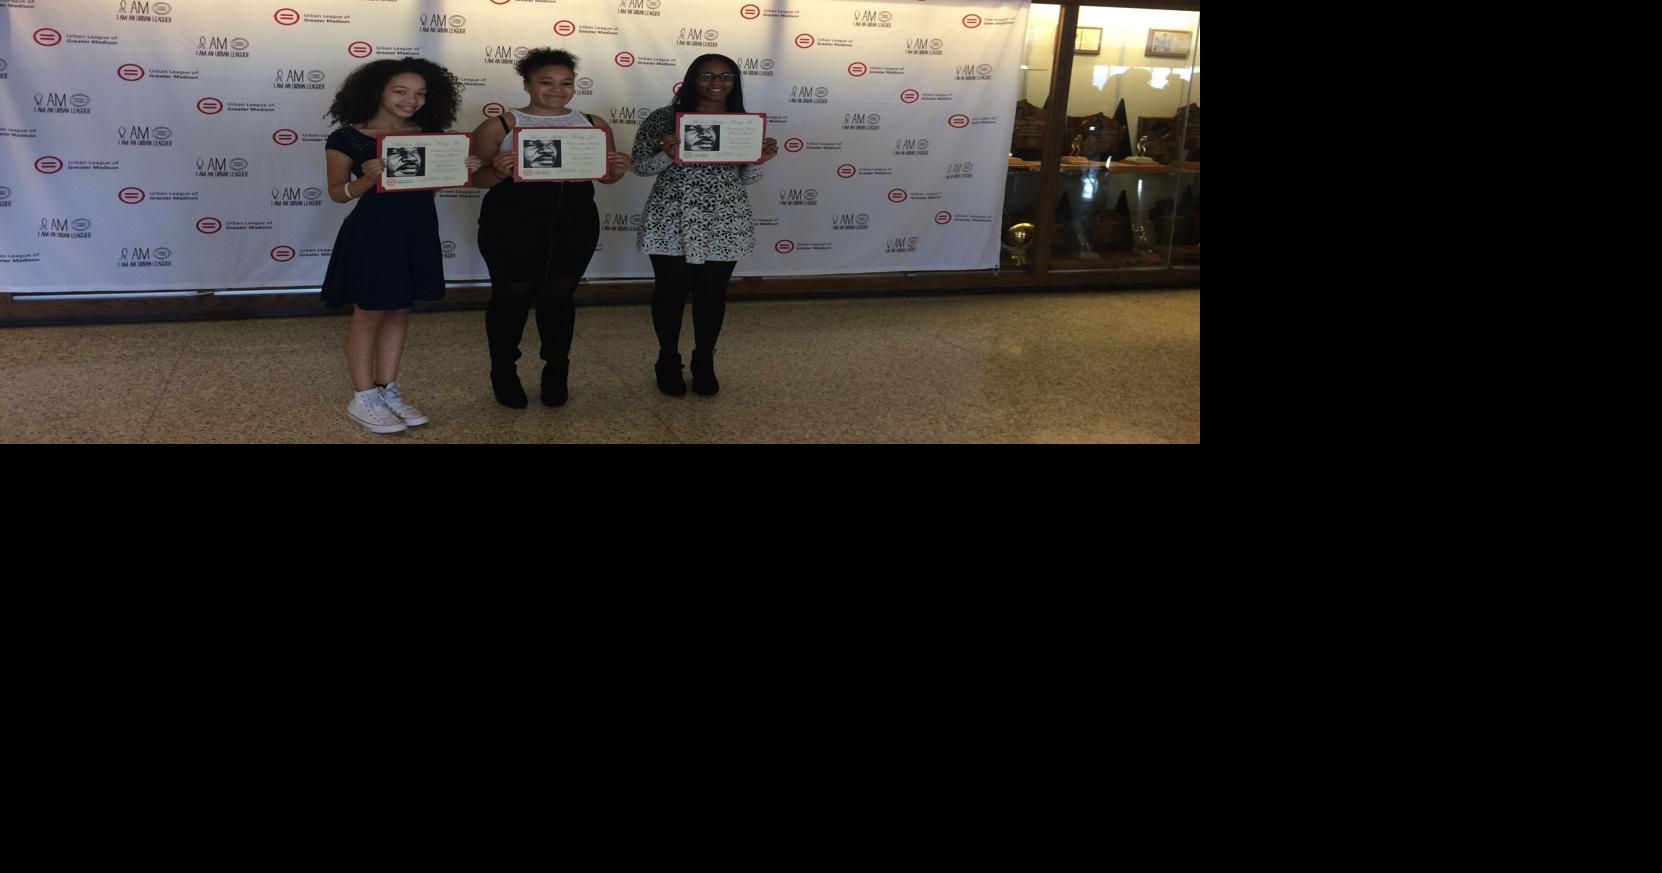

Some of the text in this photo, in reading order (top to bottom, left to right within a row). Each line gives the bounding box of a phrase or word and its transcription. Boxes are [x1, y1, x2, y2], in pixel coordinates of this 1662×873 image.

[130, 2, 149, 14] AM
[430, 14, 446, 27] AM
[863, 11, 876, 21] AM
[687, 28, 701, 40] AM
[209, 37, 227, 49] AM
[914, 39, 928, 49] AM
[496, 46, 511, 58] AM
[744, 59, 758, 69] AM
[287, 70, 304, 82] AM
[799, 87, 812, 97] AM
[48, 93, 66, 106] AM
[619, 107, 635, 119] AM
[852, 114, 865, 124] AM
[130, 126, 149, 139] AM
[208, 158, 225, 171] AM
[283, 187, 300, 199] AM
[788, 189, 801, 200] AM
[51, 219, 67, 231] AM
[841, 214, 853, 224] AM
[132, 248, 149, 260] AM
